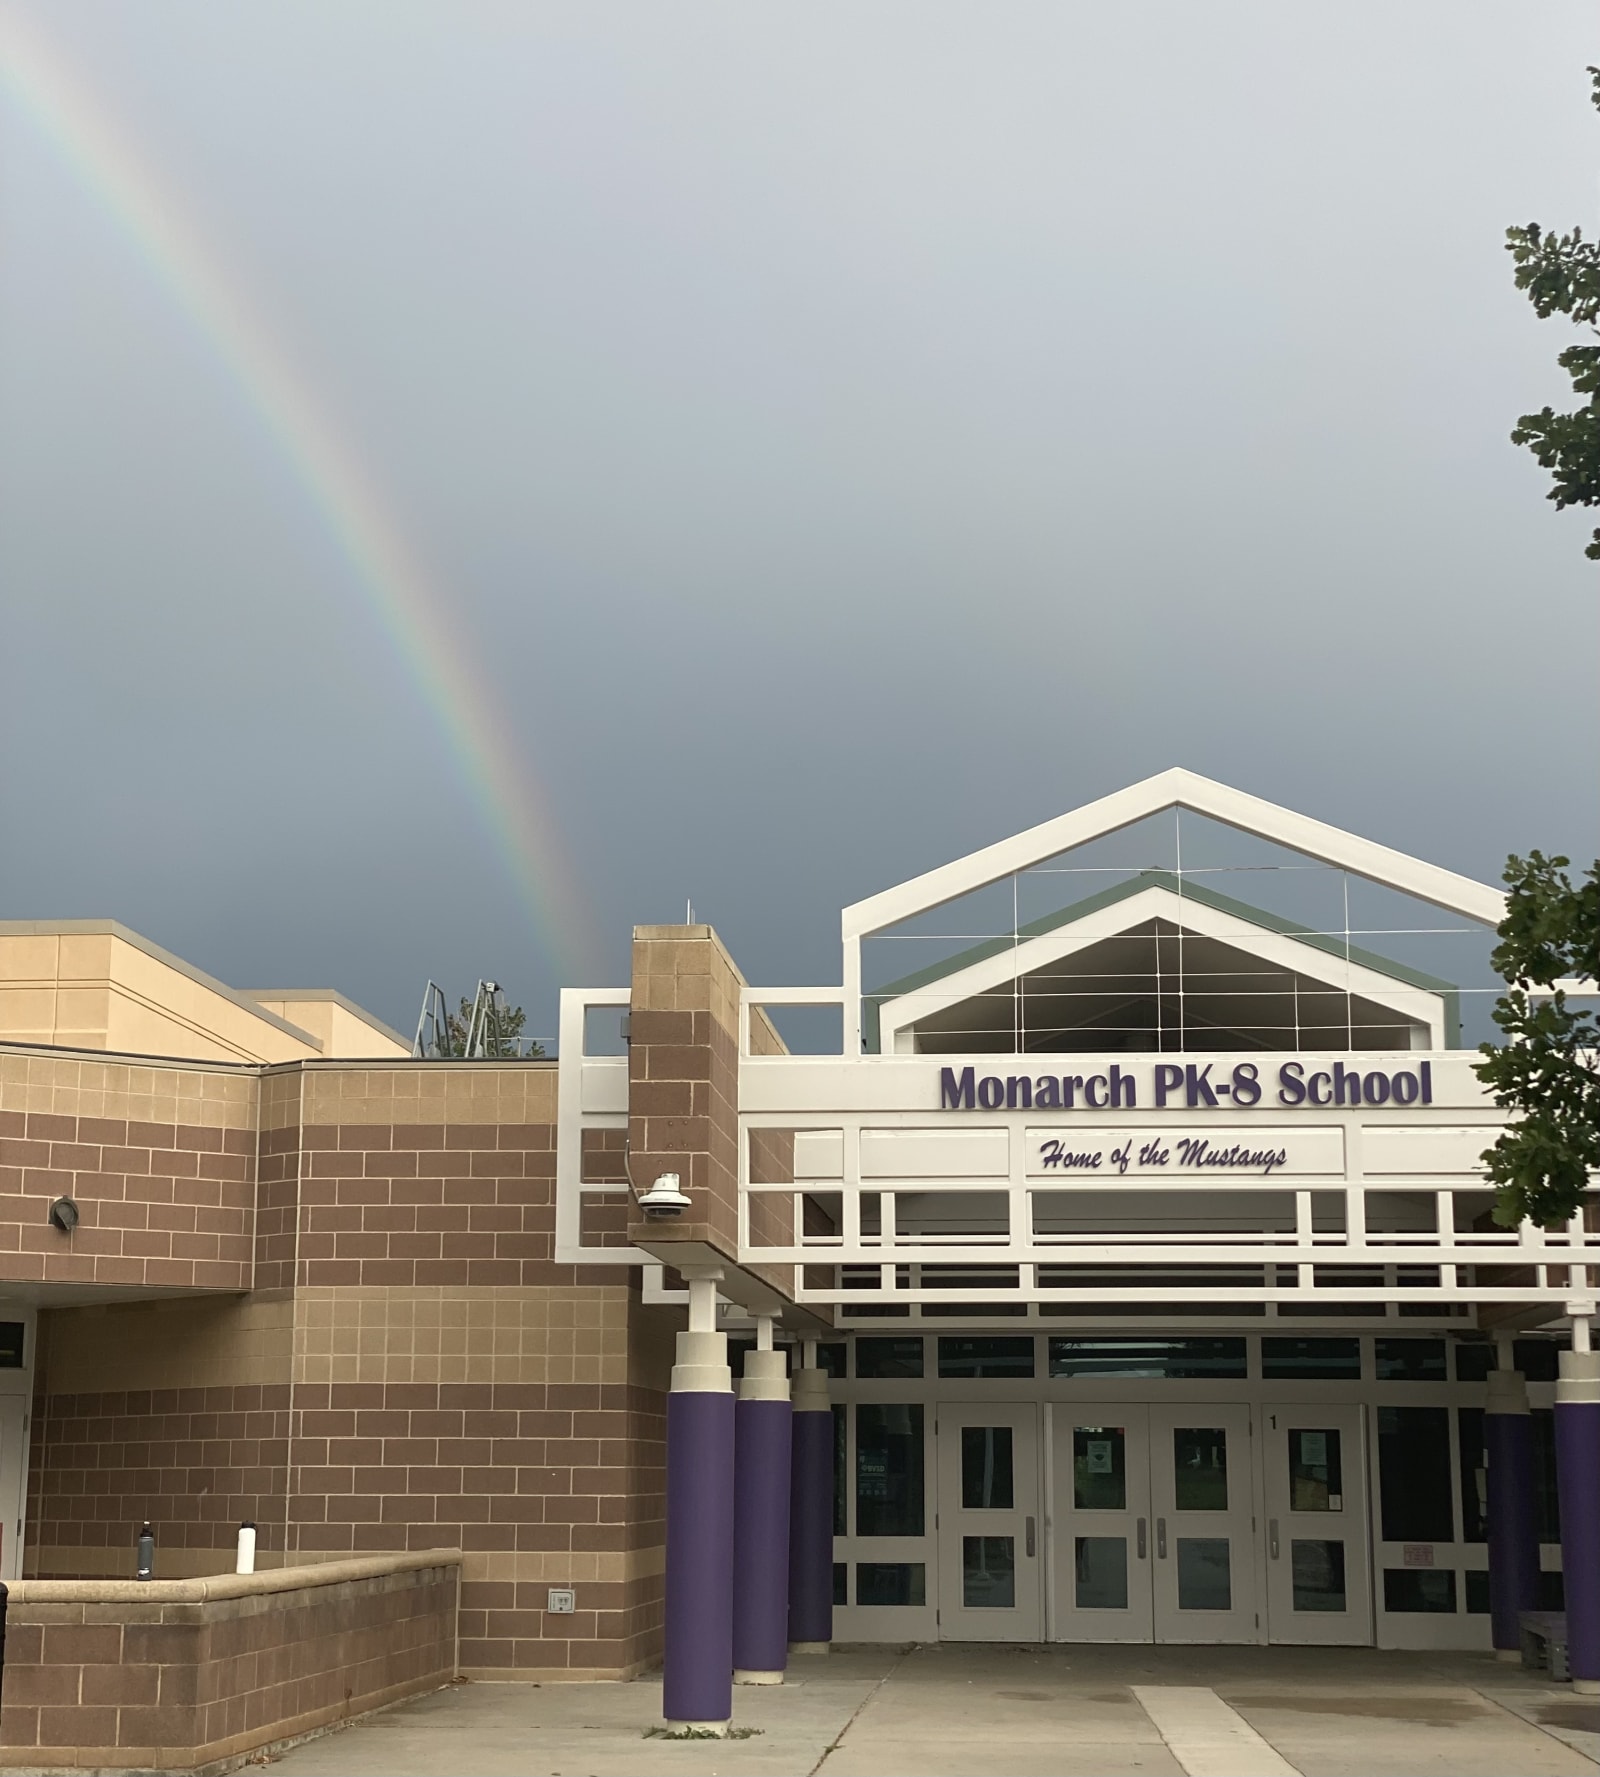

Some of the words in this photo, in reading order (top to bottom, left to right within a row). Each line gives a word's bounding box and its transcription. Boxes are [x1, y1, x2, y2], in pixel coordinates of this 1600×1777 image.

[941, 1065, 1137, 1108] Monarch
[1154, 1062, 1262, 1107] PK-8
[1278, 1060, 1433, 1105] School
[1039, 1139, 1102, 1168] Home
[1110, 1139, 1132, 1174] of
[1138, 1137, 1169, 1167] the
[1176, 1137, 1287, 1175] Mustangs
[1269, 1414, 1277, 1430] 1
